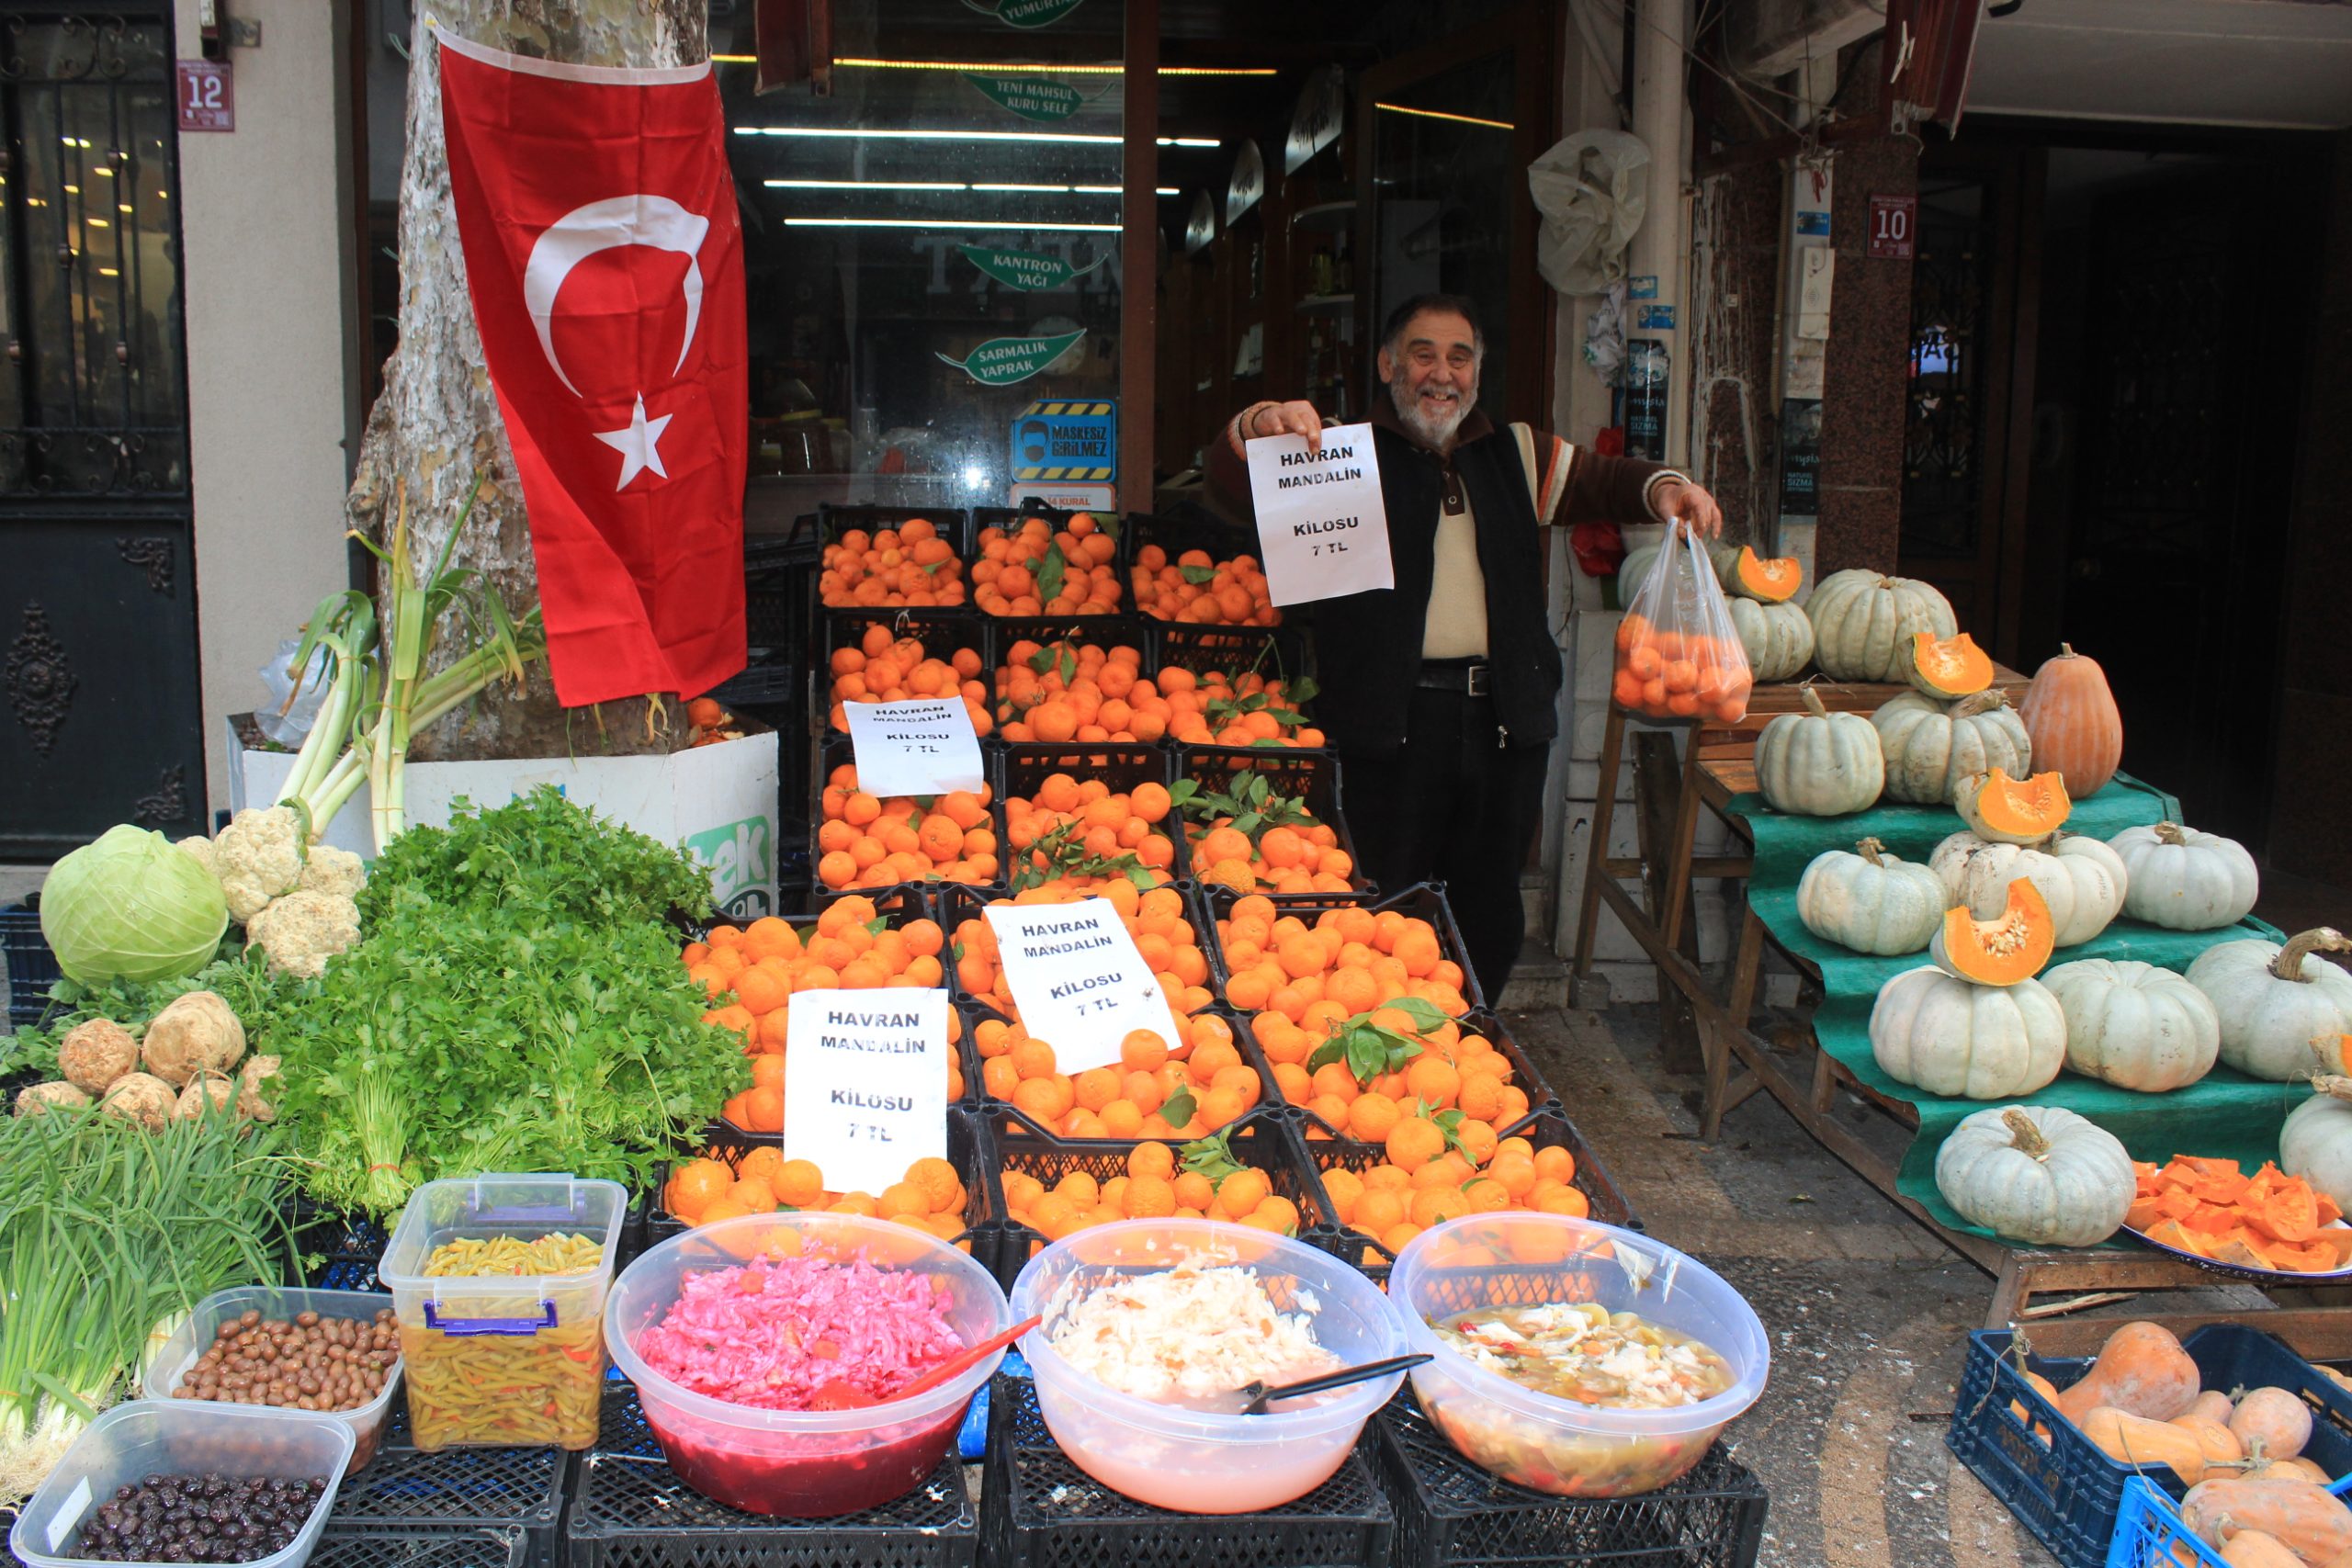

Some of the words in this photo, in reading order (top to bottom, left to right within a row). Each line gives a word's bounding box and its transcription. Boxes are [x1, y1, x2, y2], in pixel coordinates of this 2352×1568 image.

[188, 75, 222, 108] 12
[997, 80, 1023, 94] YENİ
[1026, 84, 1074, 100] MAHSUL
[1007, 96, 1039, 111] KURU
[1043, 101, 1069, 115] SELE
[1877, 209, 1906, 240] 10
[993, 254, 1062, 274] KANTRON
[1016, 273, 1047, 288] YAĞI
[978, 342, 1047, 363] SARMALIK
[980, 359, 1035, 378] YAPRAK
[1281, 446, 1353, 467] HAVRAN
[1278, 467, 1362, 489] MANDALİN
[1058, 497, 1091, 506] KURAL
[1294, 516, 1359, 536] KİLOSU
[1311, 546, 1321, 557] 7
[1328, 542, 1348, 554] TL
[873, 713, 952, 723] MANDALİN
[876, 705, 944, 716] HAVRAN
[919, 745, 940, 753] TL
[1022, 919, 1099, 937] HAVRAN
[1023, 935, 1113, 958] MANDALİN
[1050, 972, 1123, 999] KİLOSU
[1075, 1004, 1086, 1016] 7
[1092, 997, 1118, 1010] TL
[828, 1010, 920, 1028] HAVRAN
[820, 1035, 926, 1053] MANDALİN
[831, 1088, 913, 1111] KİLOSU
[849, 1122, 859, 1138] 7
[866, 1124, 892, 1142] TL
